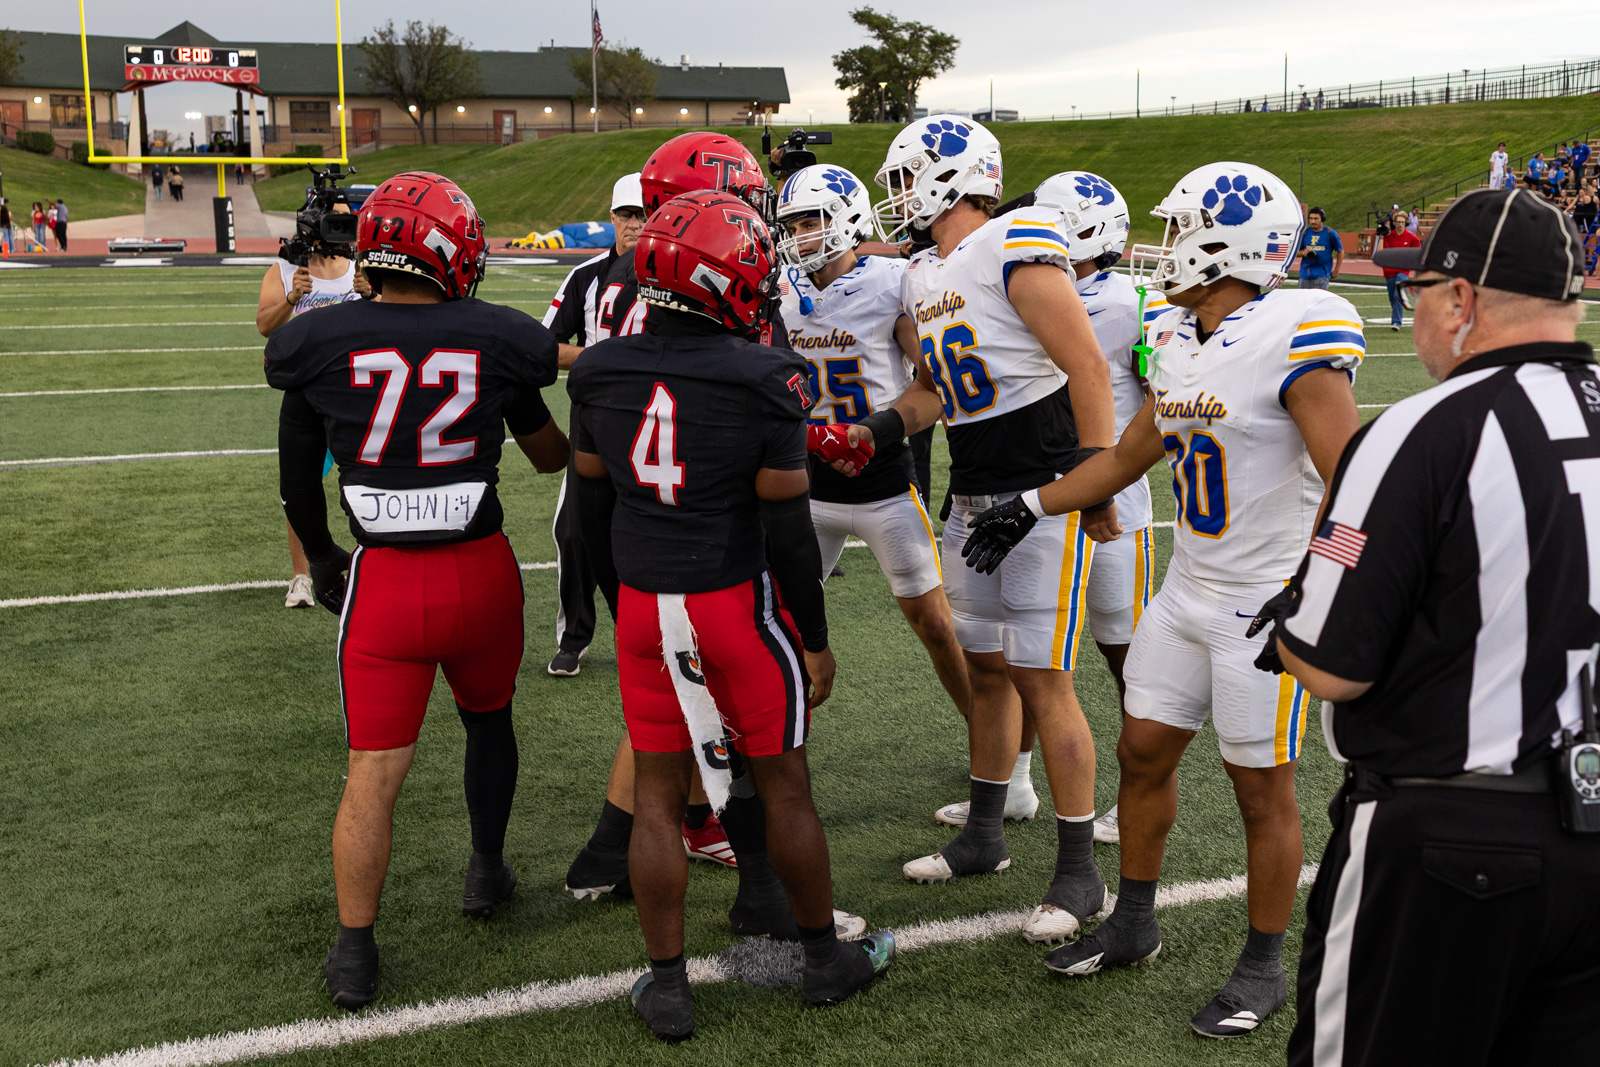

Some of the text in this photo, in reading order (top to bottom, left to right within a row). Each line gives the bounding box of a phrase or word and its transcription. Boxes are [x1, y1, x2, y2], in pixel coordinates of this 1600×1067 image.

[153, 49, 164, 65] 0
[228, 52, 239, 67] 0
[371, 216, 405, 242] 72
[367, 249, 408, 265] schutt
[646, 250, 657, 276] 4
[1442, 249, 1459, 269] S
[640, 285, 673, 302] schutt
[788, 328, 857, 353] Frenship
[787, 372, 813, 411] T
[349, 347, 482, 467] 72
[629, 381, 686, 507] 4
[360, 492, 438, 523] JOHN
